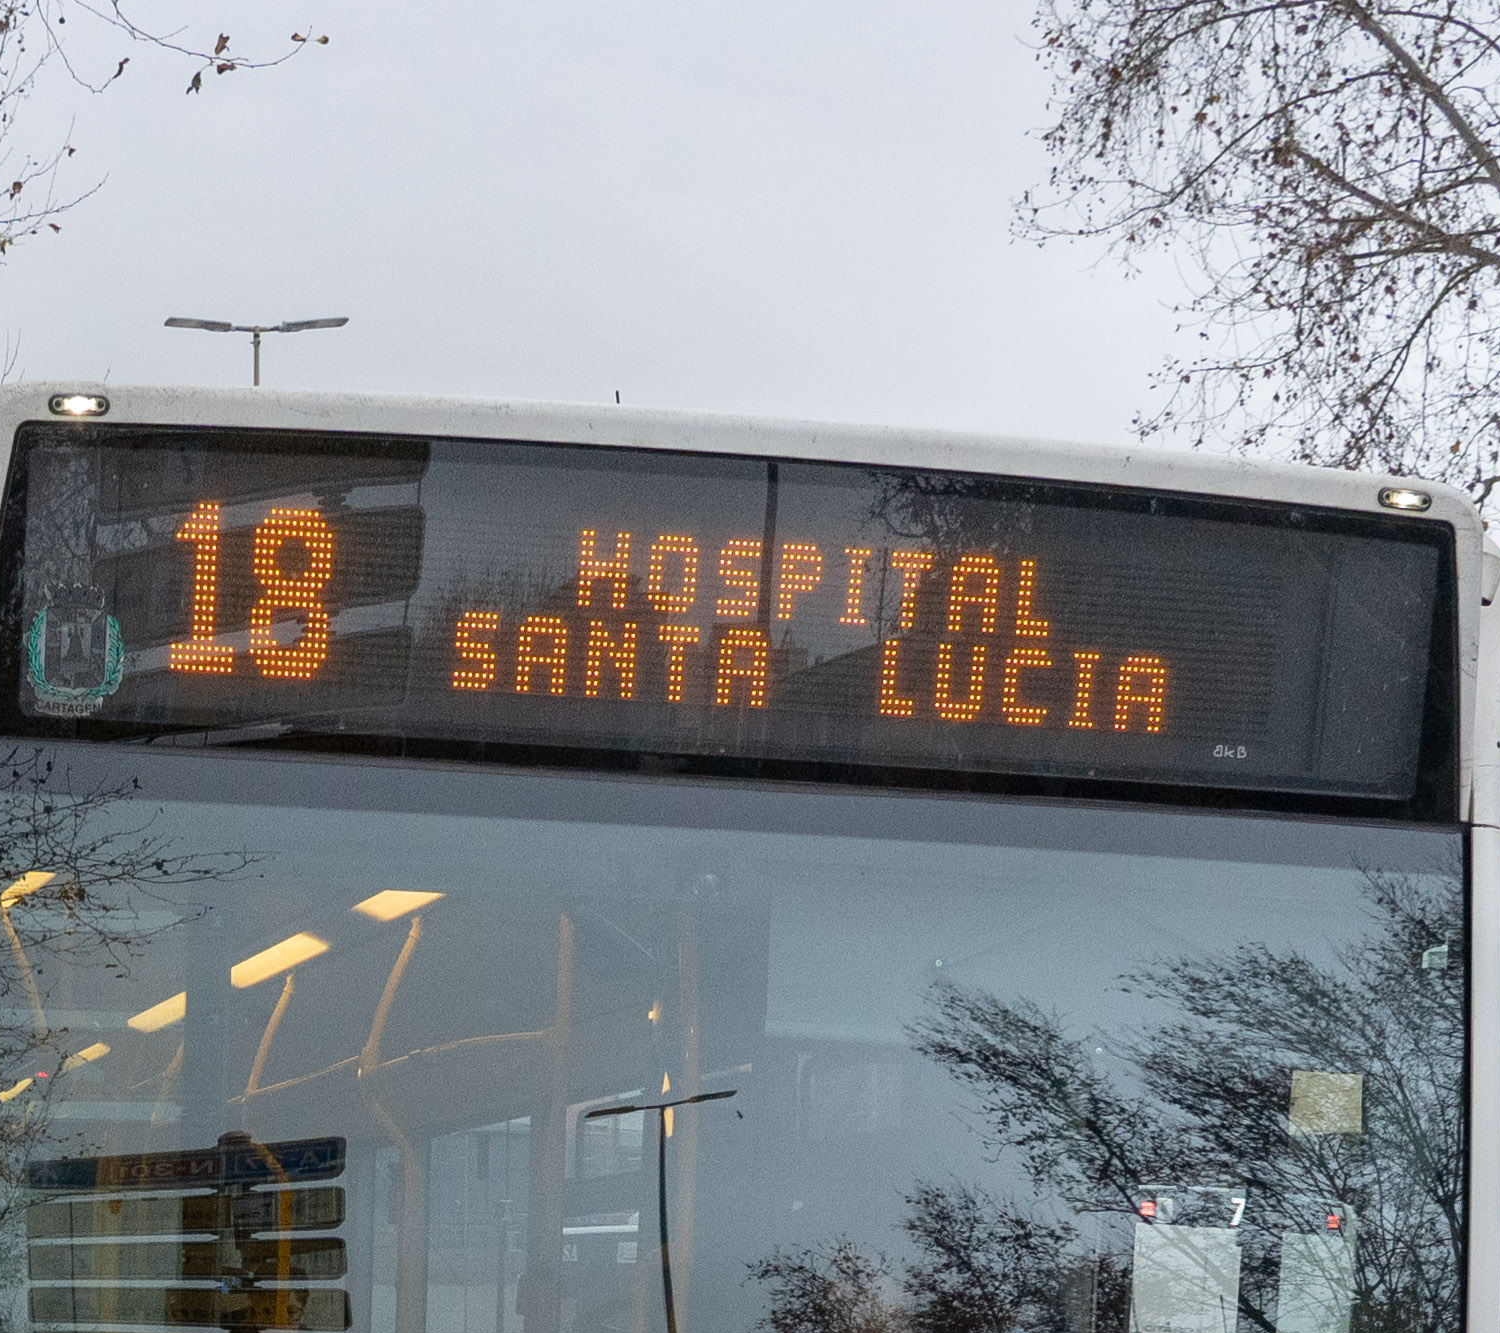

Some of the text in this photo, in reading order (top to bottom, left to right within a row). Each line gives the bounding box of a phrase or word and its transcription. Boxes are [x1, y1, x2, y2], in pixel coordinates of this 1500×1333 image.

[168, 500, 334, 679] 18
[576, 528, 1049, 638] HOSPITAL
[451, 611, 1168, 733] SANTA LUCIA
